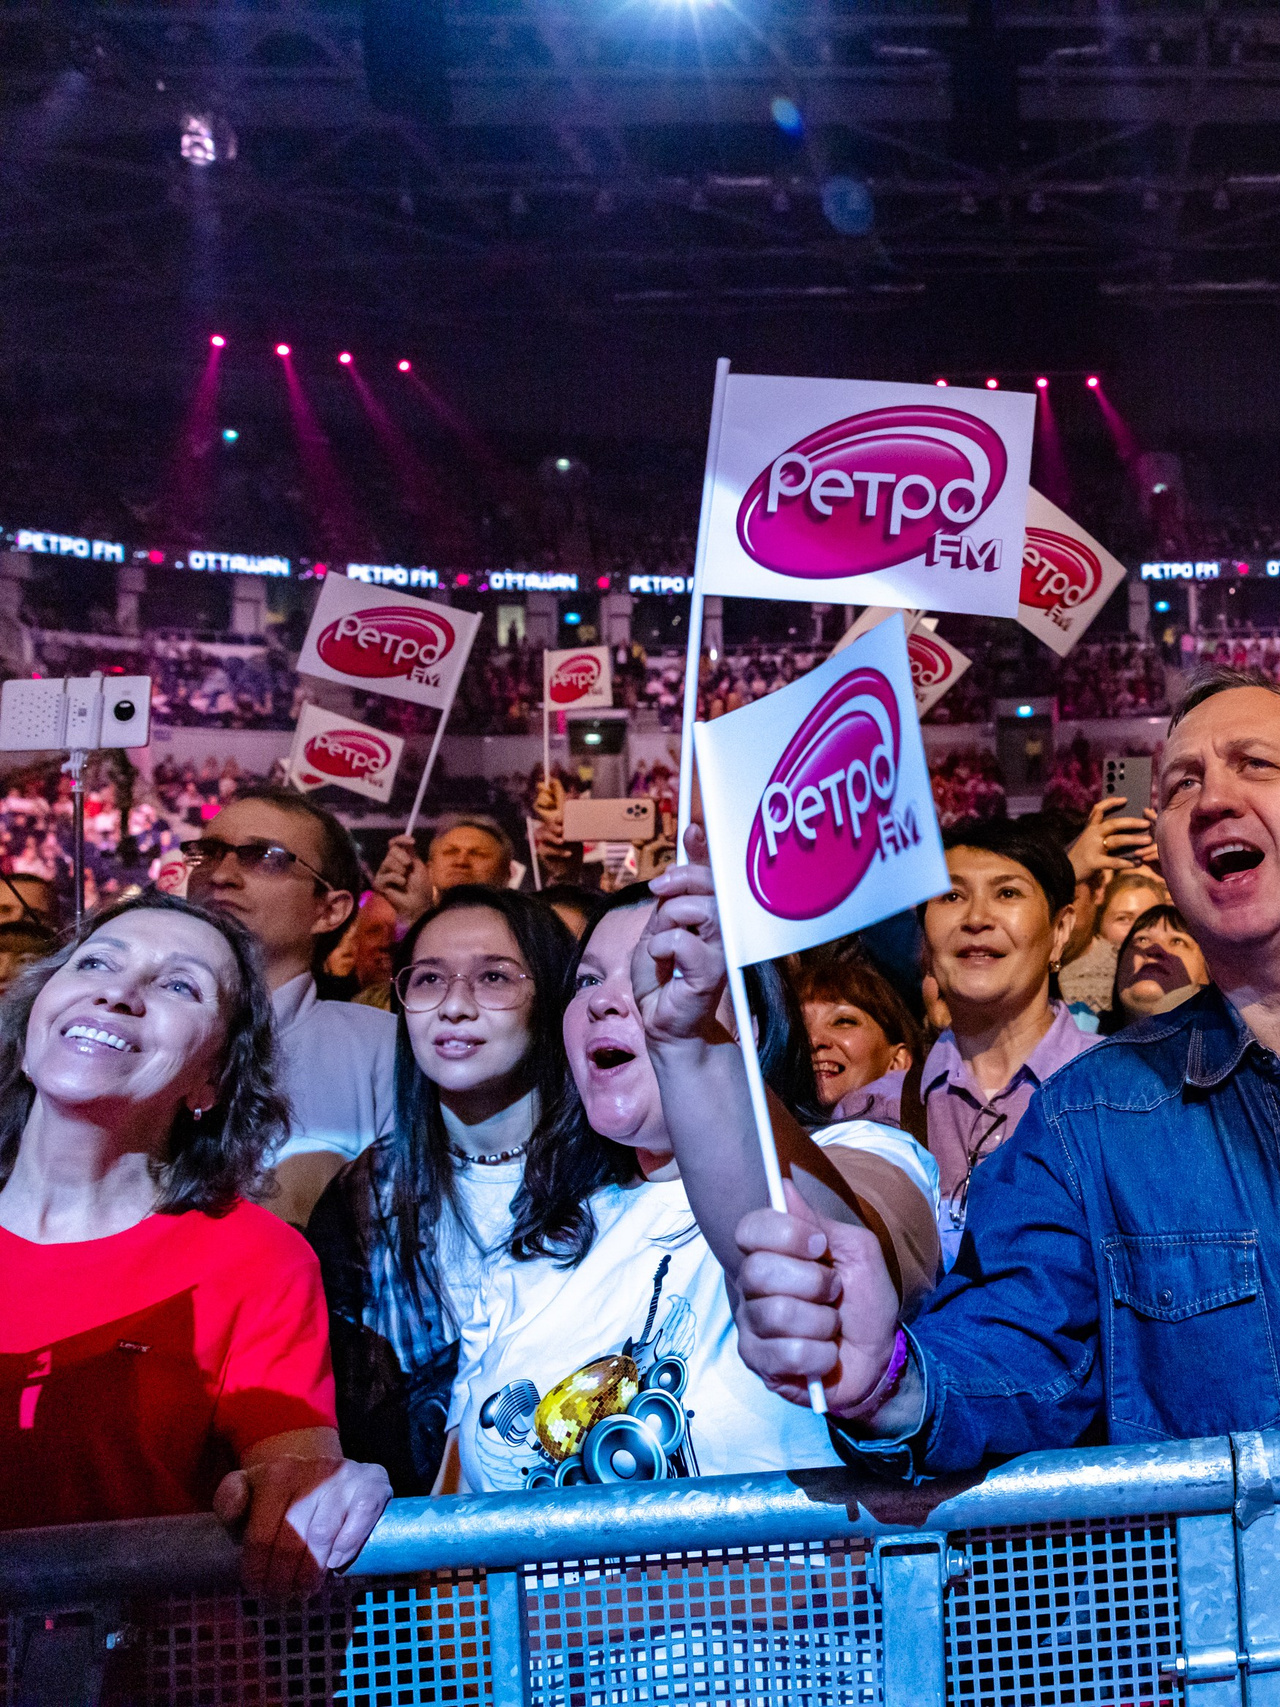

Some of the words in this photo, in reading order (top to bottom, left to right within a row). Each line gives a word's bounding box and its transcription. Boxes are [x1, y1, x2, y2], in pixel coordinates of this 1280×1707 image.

[766, 452, 983, 535] Ретро
[928, 533, 1003, 572] FM
[17, 529, 90, 558] РЕТРО
[92, 540, 124, 562] FM
[189, 551, 290, 577] OTTAWAN
[1023, 547, 1084, 606] етро
[1141, 562, 1193, 580] РЕТРО
[1195, 562, 1219, 579] FM
[410, 569, 438, 588] FM
[629, 575, 685, 593] РЕТРО
[406, 666, 441, 688] FM
[762, 743, 896, 857] Ретро
[876, 803, 923, 862] FM
